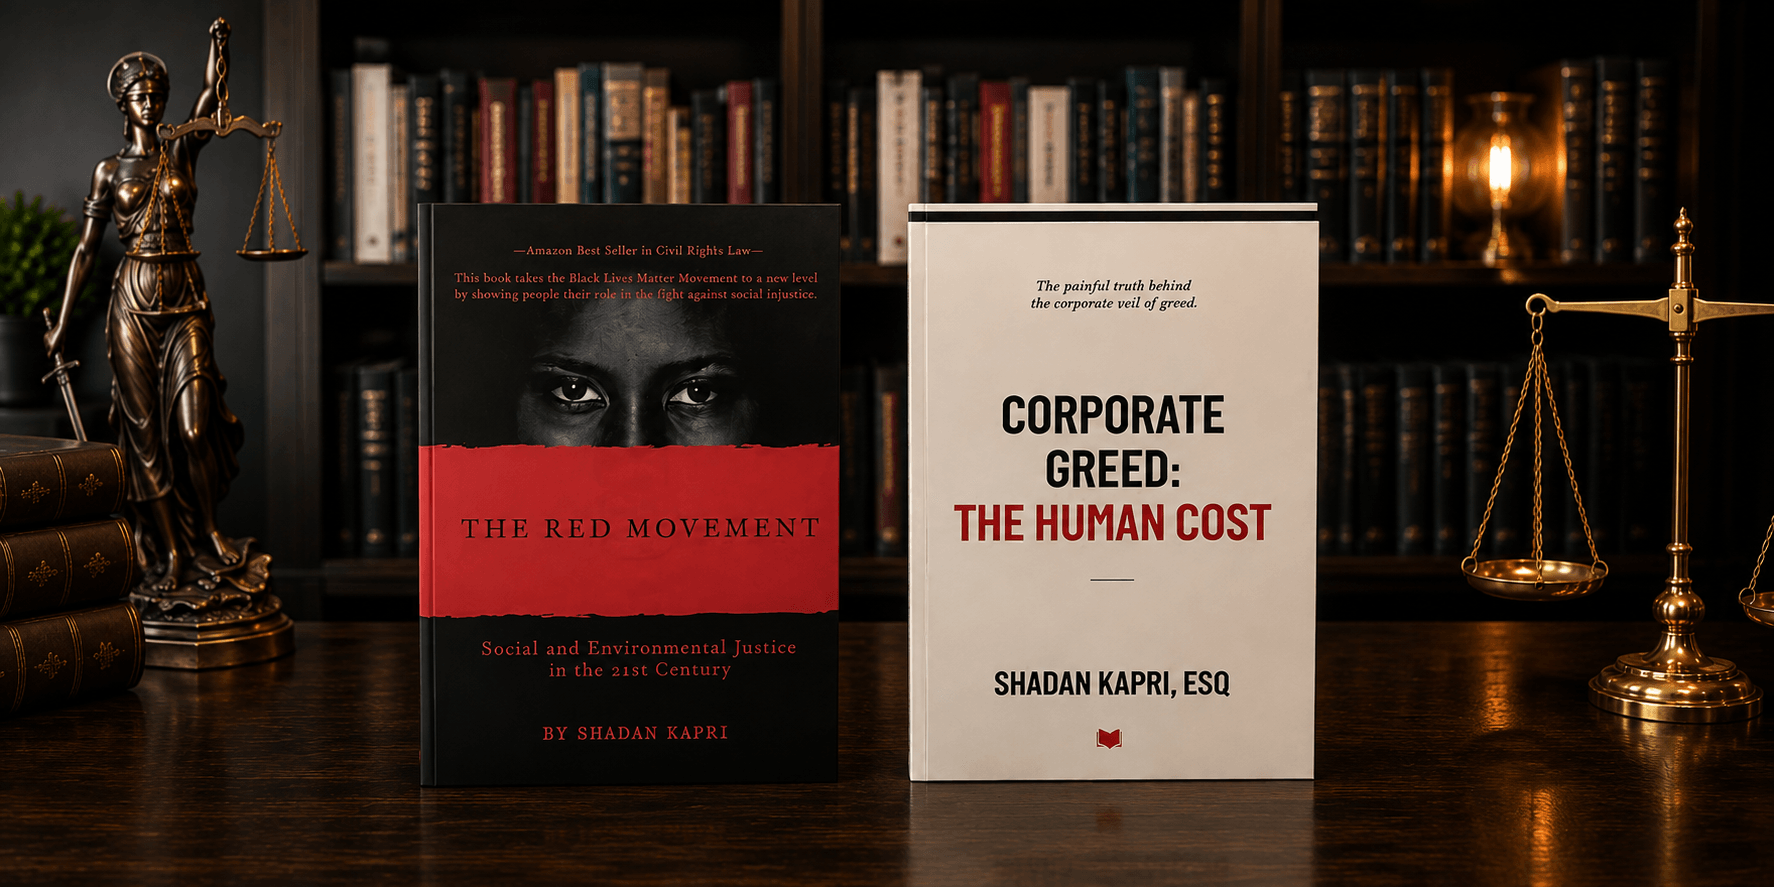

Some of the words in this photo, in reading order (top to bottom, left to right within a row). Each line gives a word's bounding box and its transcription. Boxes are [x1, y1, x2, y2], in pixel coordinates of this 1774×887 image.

[577, 245, 601, 256] Best
[604, 244, 638, 256] Seller
[641, 245, 652, 256] in
[655, 244, 683, 256] Civil
[687, 244, 724, 258] Rights
[454, 272, 480, 283] This
[483, 272, 512, 283] book
[515, 271, 544, 283] takes
[547, 272, 566, 283] the
[569, 272, 600, 283] Black
[603, 272, 633, 284] Lives
[636, 272, 675, 283] Matter
[678, 272, 738, 283] Movement
[741, 275, 753, 283] to
[756, 275, 763, 283] a
[766, 275, 789, 283] new
[792, 271, 818, 283] level
[1036, 279, 1061, 292] The
[1063, 279, 1111, 295] painful
[1113, 279, 1145, 292] truth
[1148, 279, 1193, 292] behind
[454, 288, 468, 302] by
[471, 288, 519, 302] showing
[522, 288, 560, 303] people
[563, 288, 592, 300] their
[594, 288, 617, 300] role
[620, 288, 632, 299] in
[635, 288, 654, 299] the
[657, 288, 684, 302] fight
[687, 288, 727, 303] against
[730, 288, 763, 300] social
[766, 288, 817, 302] injustice.
[1030, 296, 1051, 309] the
[1053, 299, 1114, 312] corporate
[1117, 296, 1141, 309] veil
[1144, 296, 1160, 312] of
[1158, 296, 1198, 312] greed.
[1002, 394, 1225, 435] CORPORATE
[1046, 449, 1180, 489] GREED:
[460, 518, 529, 539] THE
[544, 518, 611, 539] RED
[626, 517, 820, 539] MOVEMENT
[953, 504, 1024, 542] THE
[1036, 503, 1164, 542] HUMAN
[1176, 503, 1272, 541] COST
[481, 639, 538, 656] Social
[546, 639, 580, 656] and
[588, 638, 727, 656] Environmental
[732, 639, 797, 659] Justice
[549, 662, 567, 678] in
[574, 661, 603, 678] the
[611, 665, 648, 677] 21st
[655, 661, 732, 681] Century
[994, 670, 1091, 696] SHADAN
[1098, 670, 1177, 700] KAPRI,
[1183, 670, 1231, 698] ESQ
[542, 726, 568, 741] BY
[577, 725, 658, 741] SHADAN
[666, 725, 728, 740] KAPRI
